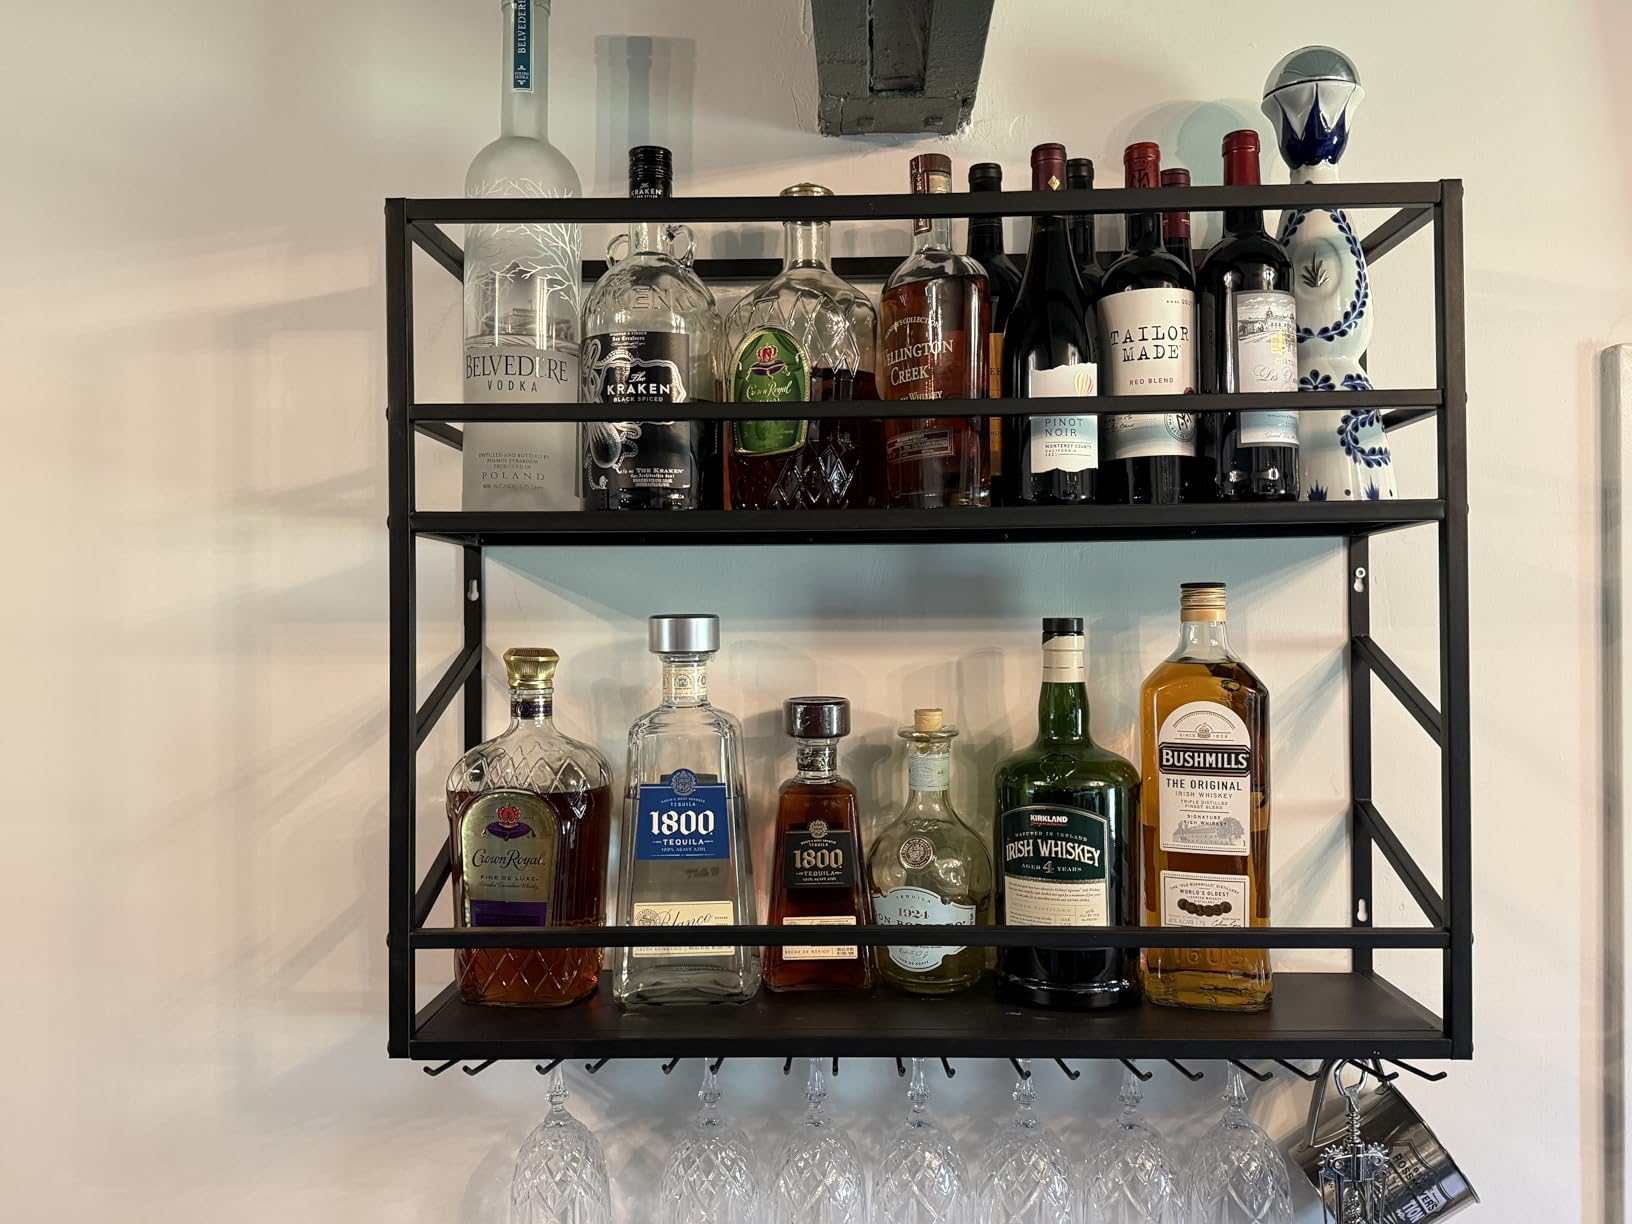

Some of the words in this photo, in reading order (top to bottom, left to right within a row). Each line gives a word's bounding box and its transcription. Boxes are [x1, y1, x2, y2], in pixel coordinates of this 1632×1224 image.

[517, 0, 527, 54] BELVEDER
[1110, 326, 1189, 346] TAILOR
[1122, 344, 1179, 362] MADE
[629, 371, 646, 383] The
[890, 365, 930, 386] CREEK
[488, 380, 538, 392] VODKA
[607, 383, 670, 395] KRAKEN
[765, 381, 793, 398] Royal
[1045, 418, 1083, 426] PINOT
[1045, 428, 1077, 436] NOIR
[481, 471, 545, 481] POLAND
[1162, 749, 1247, 769] BUSHMILLS
[1166, 778, 1185, 788] THE
[1190, 780, 1243, 791] ORIGINAL
[649, 810, 715, 836] 1800
[1029, 814, 1069, 823] KIRKLAND
[1056, 832, 1088, 842] IRELAND
[792, 848, 843, 869] 1800
[1005, 839, 1034, 862] IRISH
[1037, 838, 1101, 867] WHISKEY
[472, 849, 507, 868] Crown
[504, 849, 543, 870] Royal
[1042, 860, 1055, 873] 4
[896, 894, 931, 903] TEQUILA
[898, 908, 930, 920] 1924
